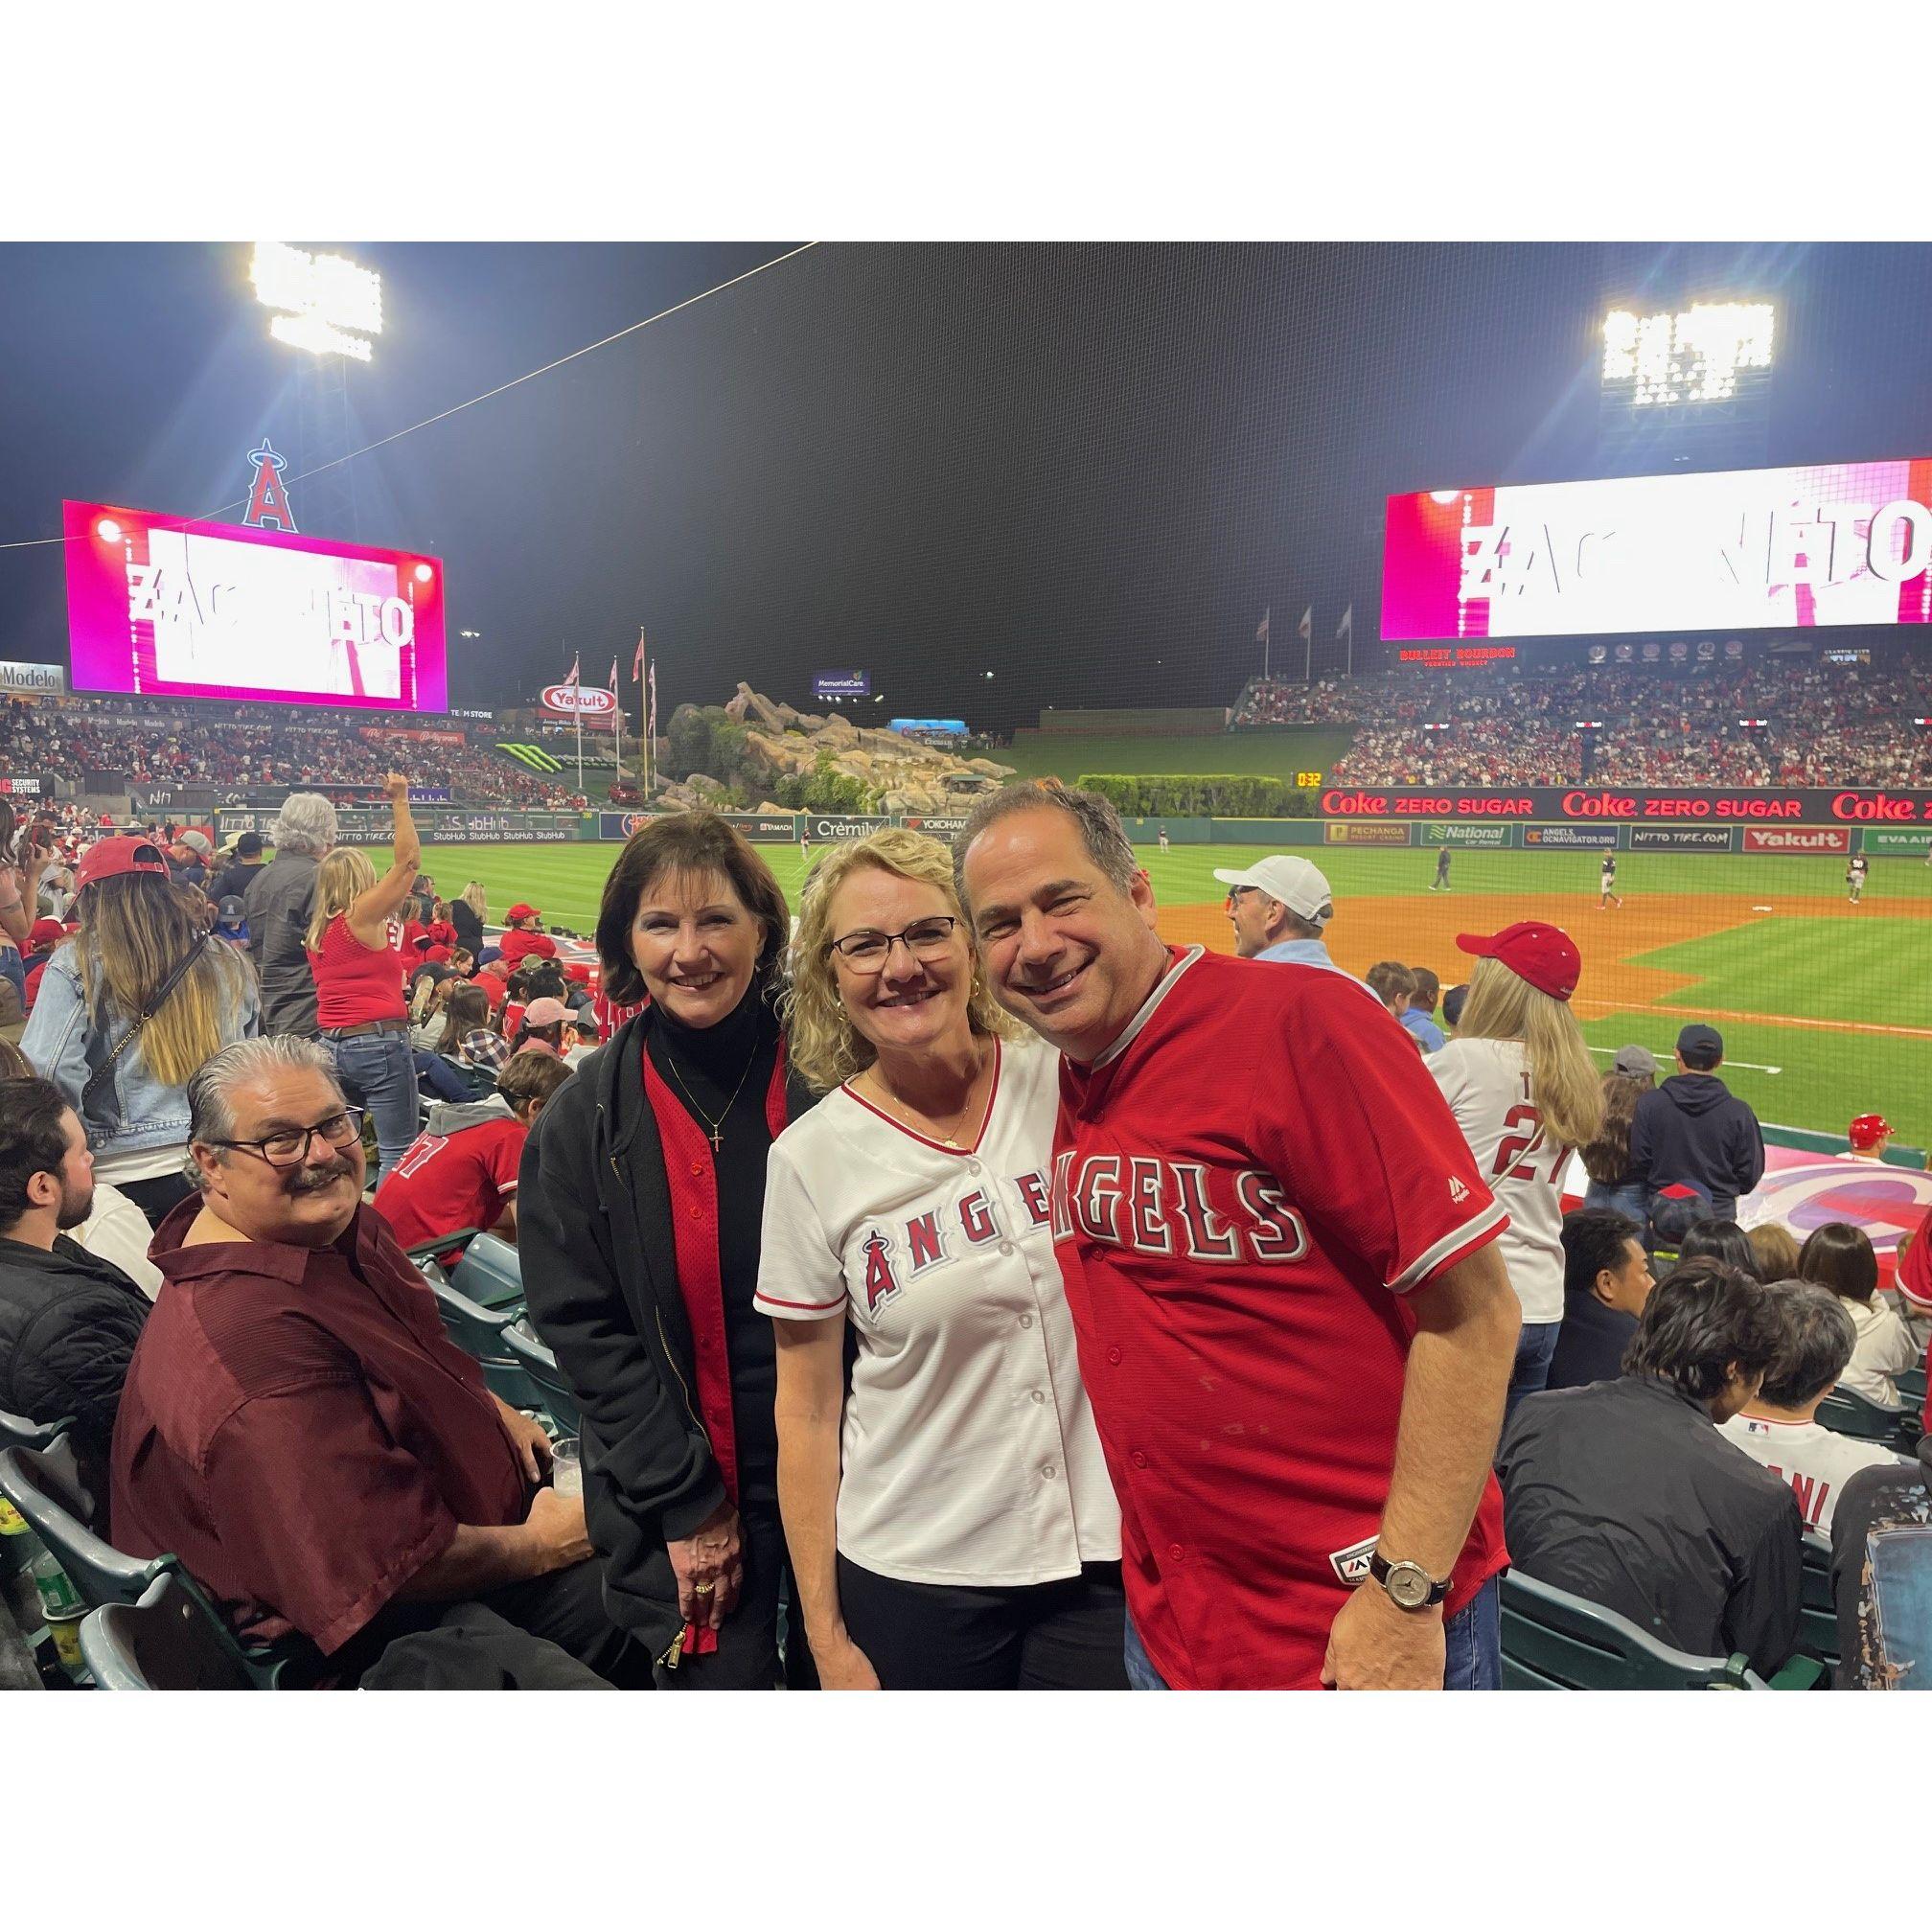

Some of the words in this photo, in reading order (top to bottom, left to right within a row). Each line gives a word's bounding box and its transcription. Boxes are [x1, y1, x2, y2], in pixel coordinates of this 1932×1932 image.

[242, 438, 299, 534] A
[3, 666, 56, 688] Modelo
[818, 679, 864, 688] MemorialCare
[1322, 790, 1389, 815] Coke
[1394, 797, 1453, 815] ZERO
[1457, 797, 1533, 815] SUGAR
[1562, 791, 1638, 817] Coke
[1644, 799, 1711, 816] ZERO
[1714, 799, 1802, 817] SUGAR
[1831, 791, 1917, 820] Coke
[767, 822, 793, 831] YAMADA
[1350, 826, 1405, 836] PECHANGA
[1446, 825, 1505, 839] National
[433, 832, 466, 841] StubHub
[469, 832, 500, 840] StubHub
[503, 831, 533, 840] StubHub
[536, 831, 565, 840] StubHub
[1542, 835, 1616, 844] OCNAVIGATOR.ORG
[1634, 831, 1669, 842] NITTO
[1673, 831, 1729, 844] TIRE.COM
[1751, 831, 1844, 847] Yakult
[1877, 835, 1908, 843] EVA
[862, 1171, 1050, 1322] ANGE
